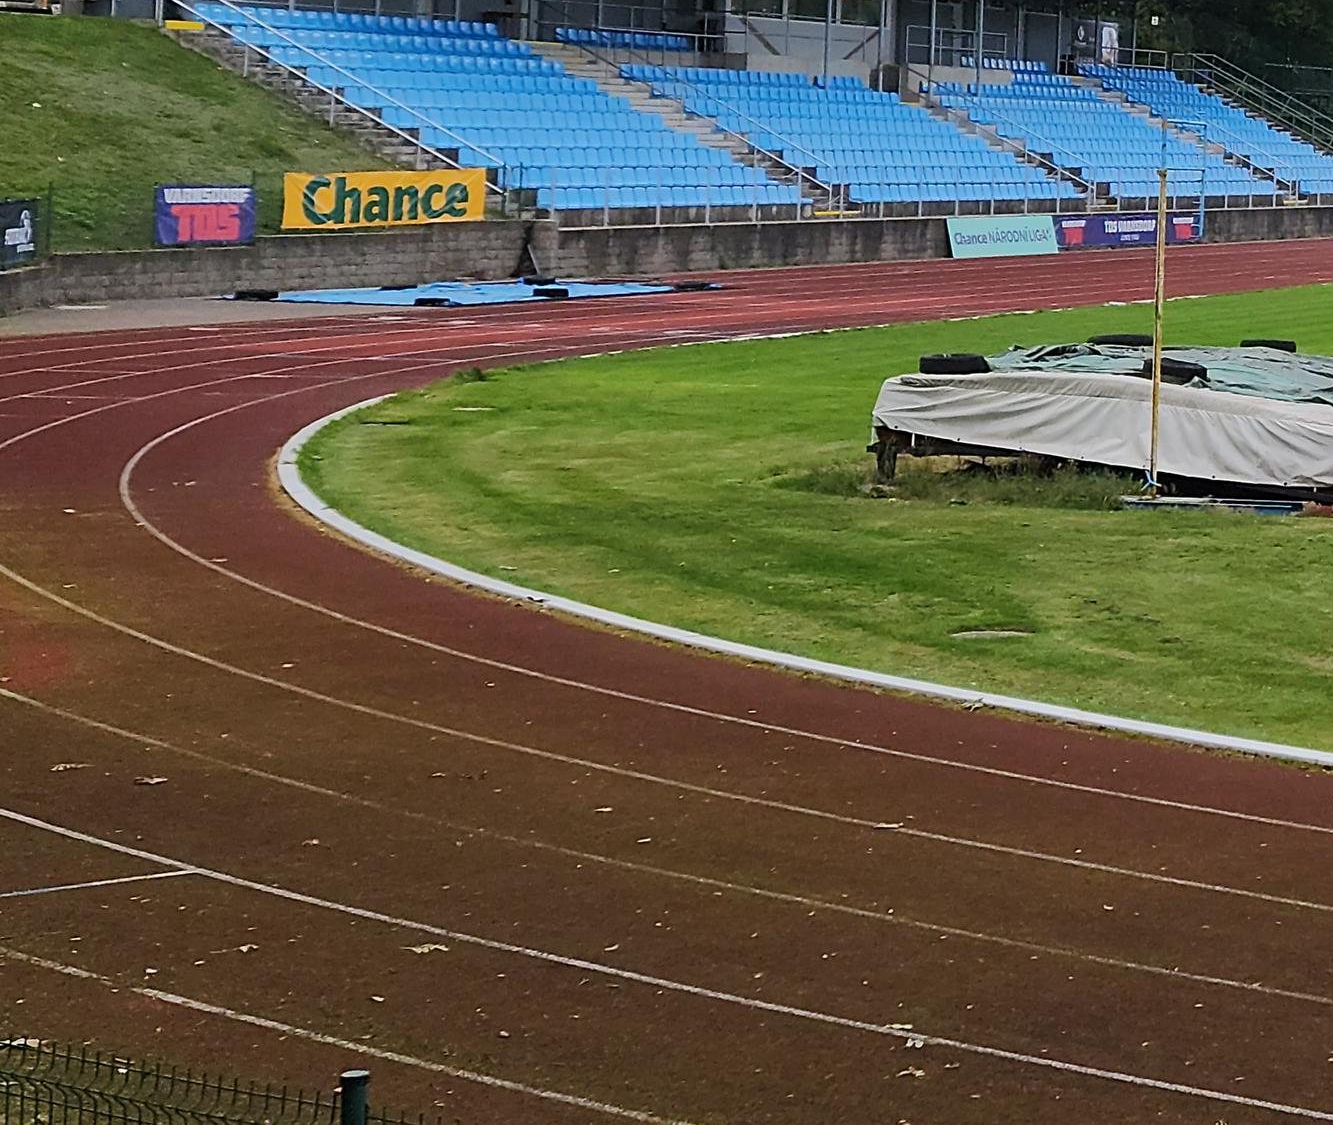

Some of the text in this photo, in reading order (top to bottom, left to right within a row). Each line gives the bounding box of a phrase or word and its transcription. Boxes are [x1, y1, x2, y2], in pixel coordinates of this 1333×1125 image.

[163, 188, 251, 203] VARNSDORF
[303, 177, 469, 225] Chance
[171, 205, 240, 241] TOS
[954, 233, 987, 245] Chance
